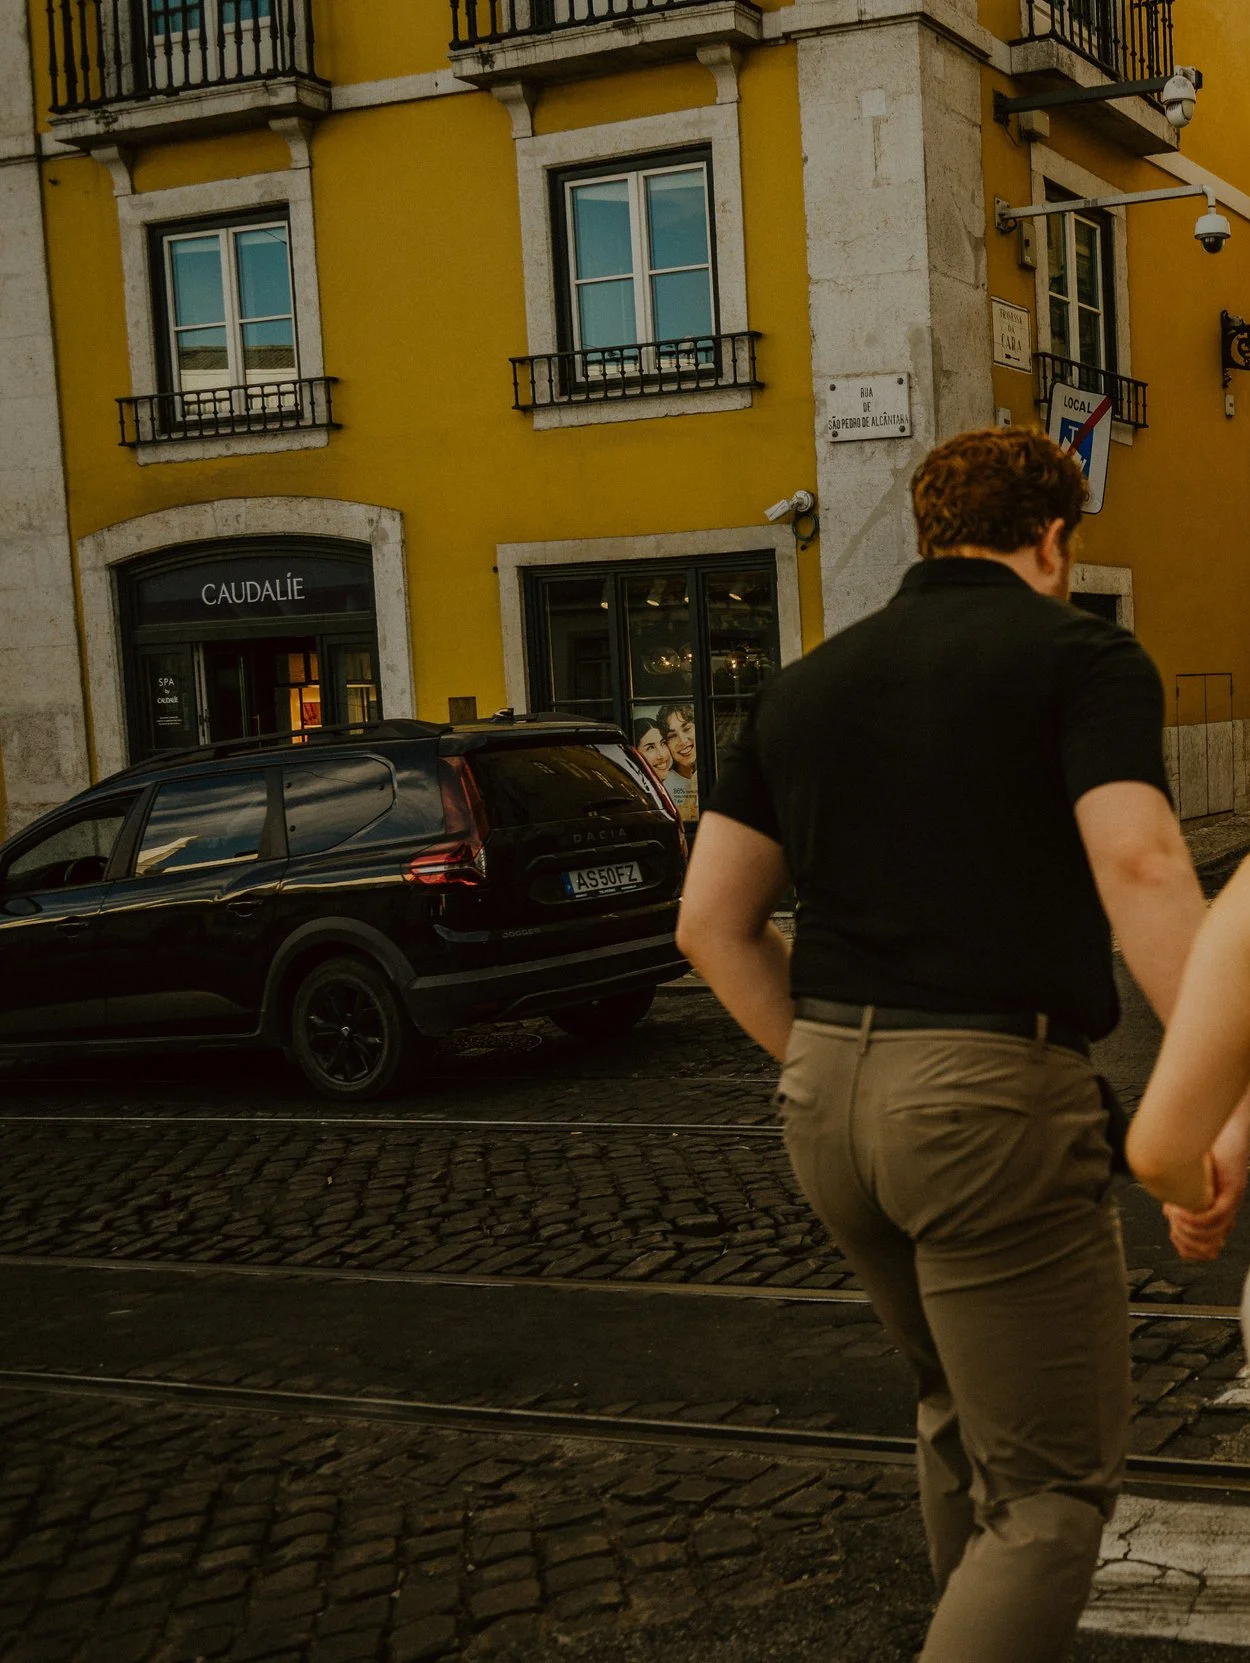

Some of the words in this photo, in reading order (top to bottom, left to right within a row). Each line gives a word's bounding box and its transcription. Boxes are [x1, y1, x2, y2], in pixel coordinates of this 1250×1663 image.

[860, 387, 874, 398] RUA
[862, 401, 872, 413] DE
[1063, 395, 1093, 414] LOCAL
[828, 415, 841, 431] SÃO
[841, 417, 861, 430] PEDRO
[861, 416, 870, 428] DE
[871, 411, 909, 427] ALCÂNTARA
[201, 571, 306, 605] CAUDALÍE
[158, 677, 175, 687] SPA
[573, 828, 627, 844] DACIA
[576, 864, 638, 890] AS50FZ
